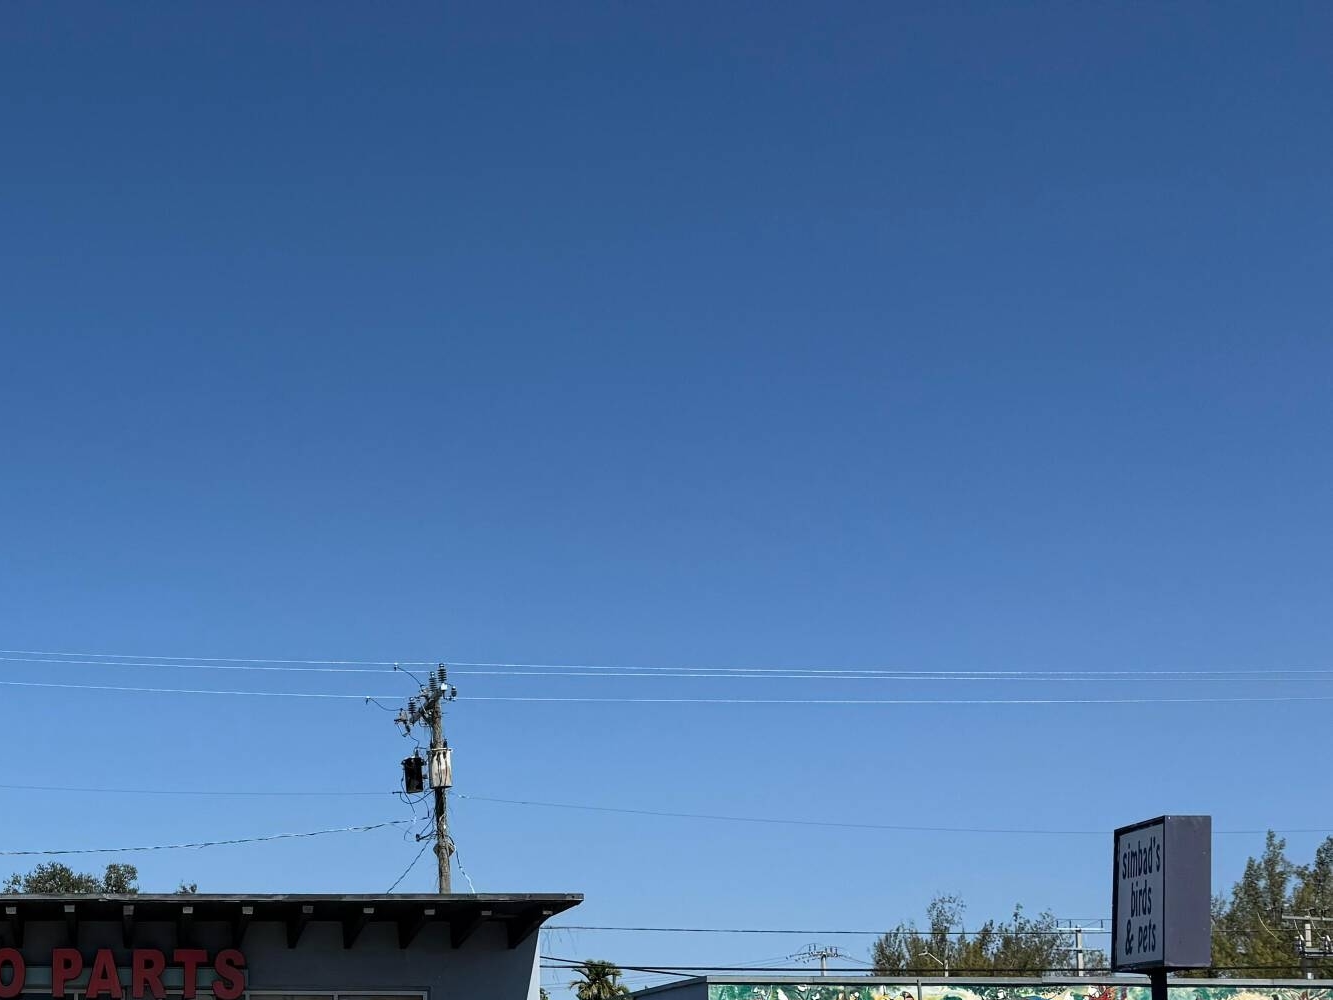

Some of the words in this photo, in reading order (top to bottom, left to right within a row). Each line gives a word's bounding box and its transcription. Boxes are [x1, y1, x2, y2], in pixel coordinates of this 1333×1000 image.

[1122, 836, 1161, 880] simbad's
[1130, 879, 1152, 918] birds
[1138, 919, 1156, 954] pets
[52, 947, 246, 1000] PARTS
